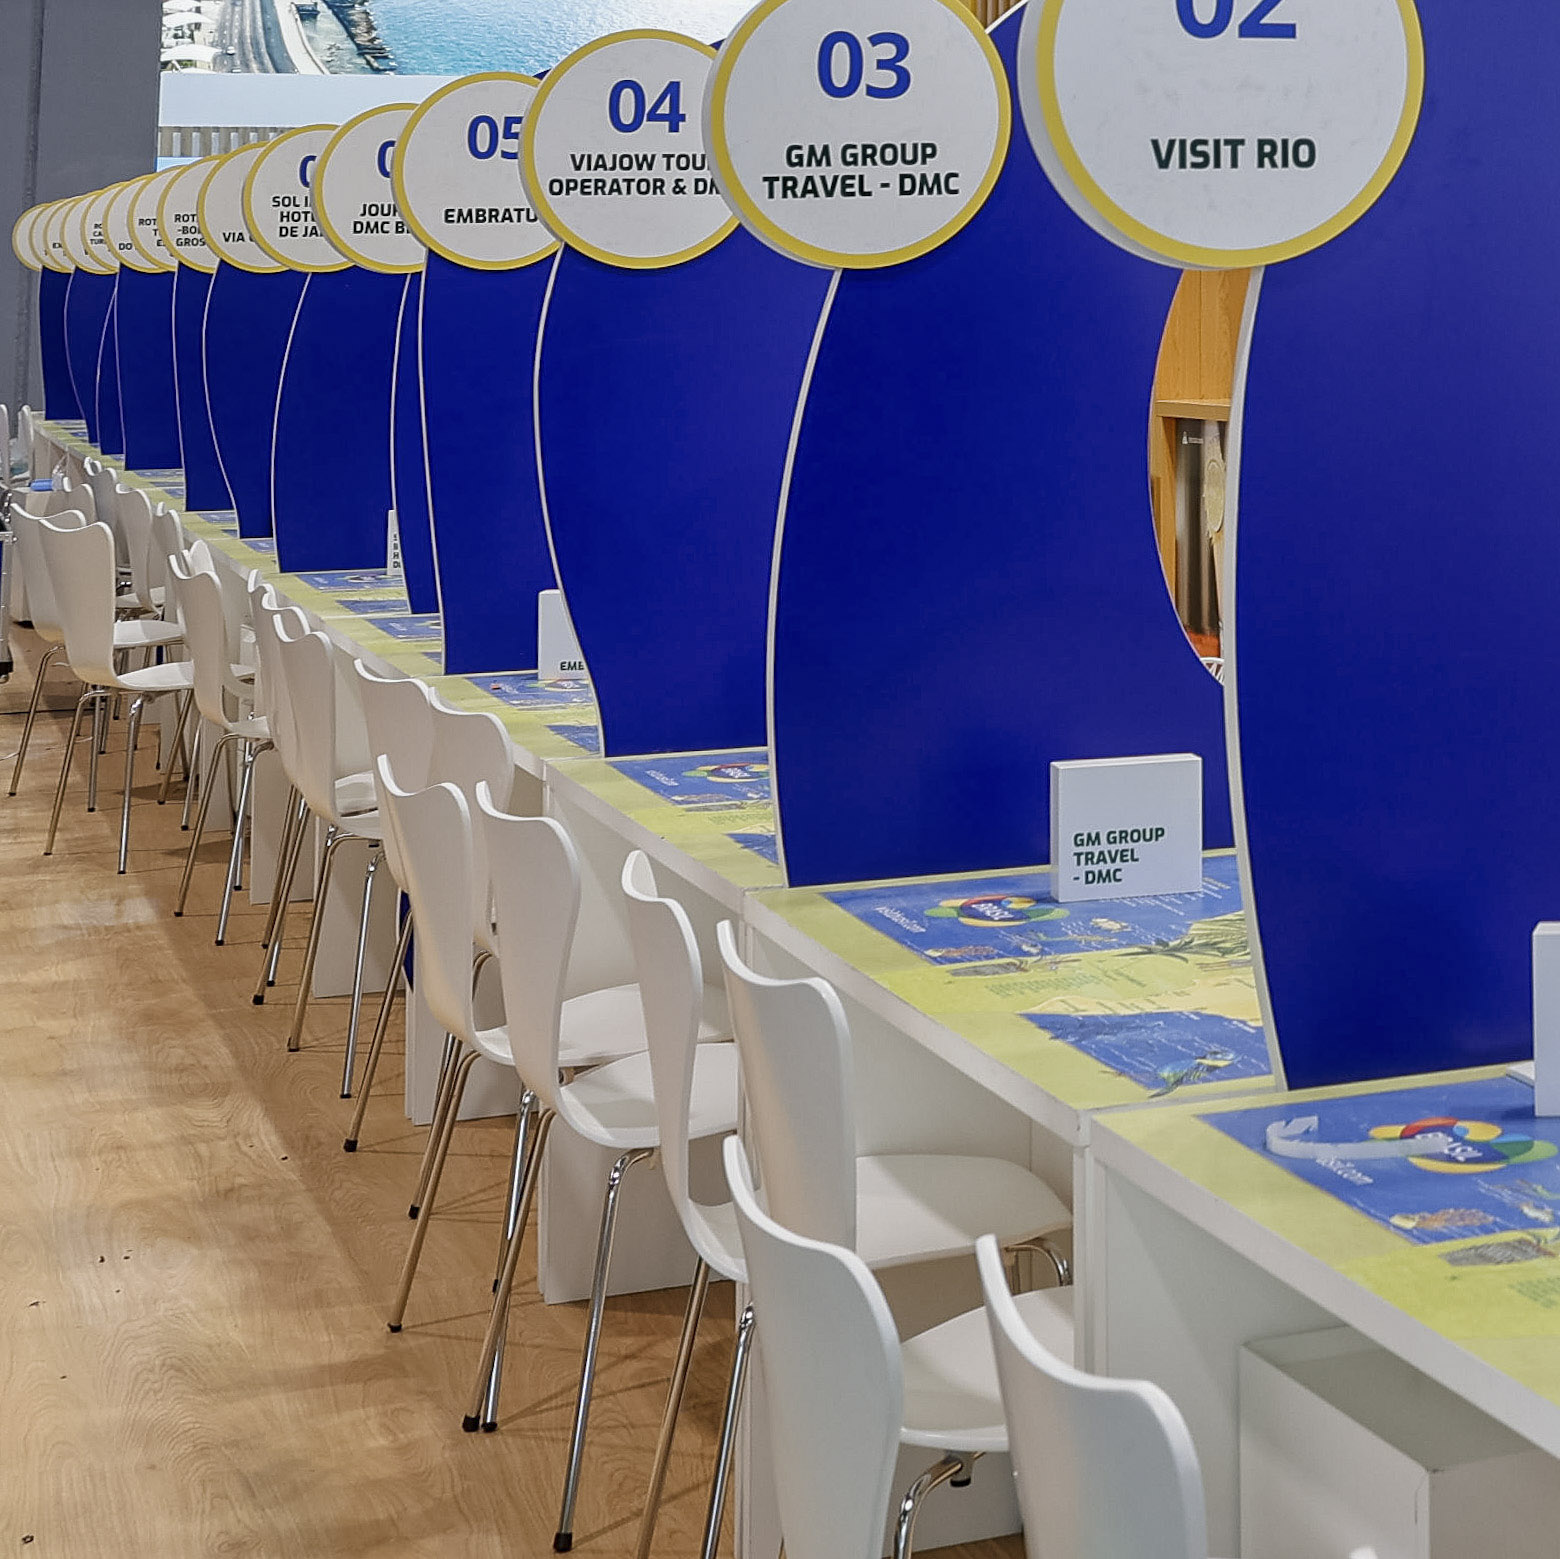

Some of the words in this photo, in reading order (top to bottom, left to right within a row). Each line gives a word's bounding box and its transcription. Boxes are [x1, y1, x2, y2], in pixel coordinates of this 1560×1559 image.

[817, 30, 911, 99] 03
[608, 79, 686, 133] 04
[467, 115, 524, 160] 05
[569, 153, 656, 171] VIAJOW
[662, 153, 710, 171] TOU
[785, 144, 832, 167] GM
[840, 142, 937, 167] GROUP
[1150, 138, 1245, 170] VISIT
[1257, 138, 1316, 169] RIO
[549, 178, 666, 196] OPERATOR
[672, 178, 687, 195] &
[762, 174, 873, 199] TRAVEL
[899, 172, 960, 196] DMC
[272, 195, 300, 208] SOL
[444, 207, 539, 223] EMBRATU
[279, 226, 298, 238] DE
[353, 220, 390, 235] DMC
[1073, 831, 1101, 848] GM
[1106, 827, 1165, 845] GROUP
[1073, 847, 1140, 867] TRAVEL
[1085, 868, 1122, 885] DMC
